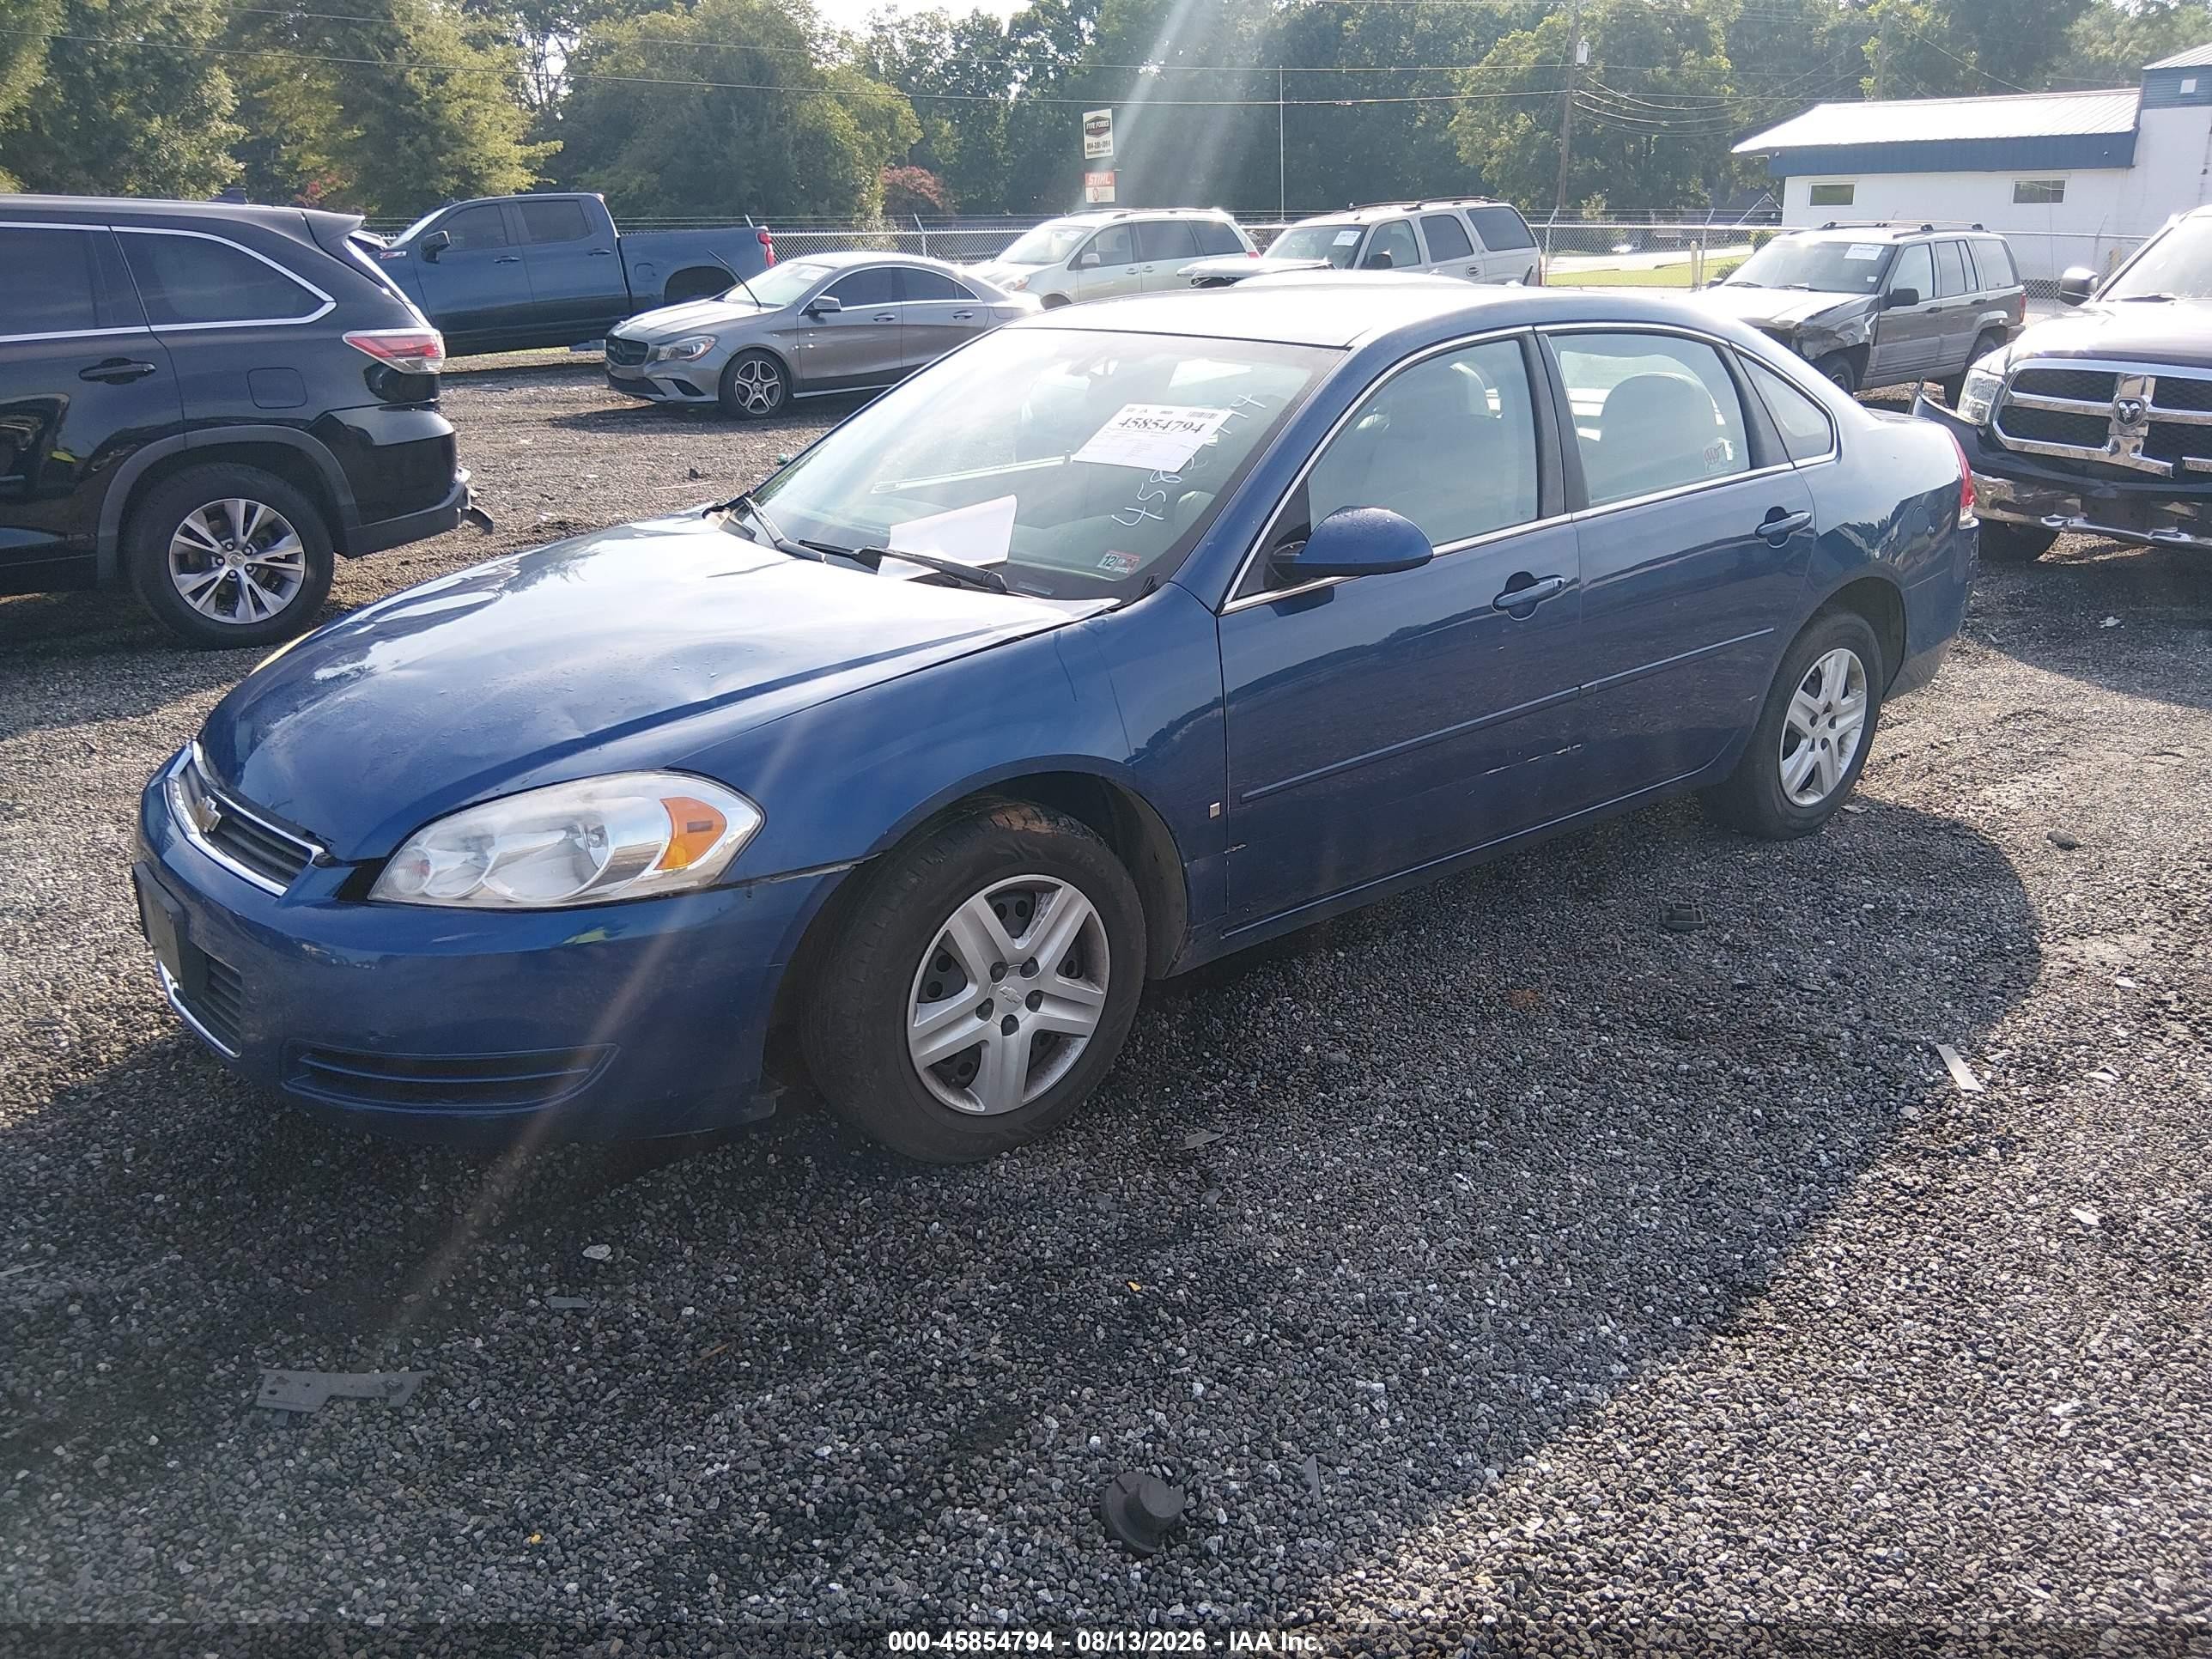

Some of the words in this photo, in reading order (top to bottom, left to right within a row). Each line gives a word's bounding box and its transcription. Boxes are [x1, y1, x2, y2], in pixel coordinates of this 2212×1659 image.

[1088, 173, 1110, 185] STIHL
[1118, 416, 1206, 434] 45854794
[1103, 555, 1117, 567] 12
